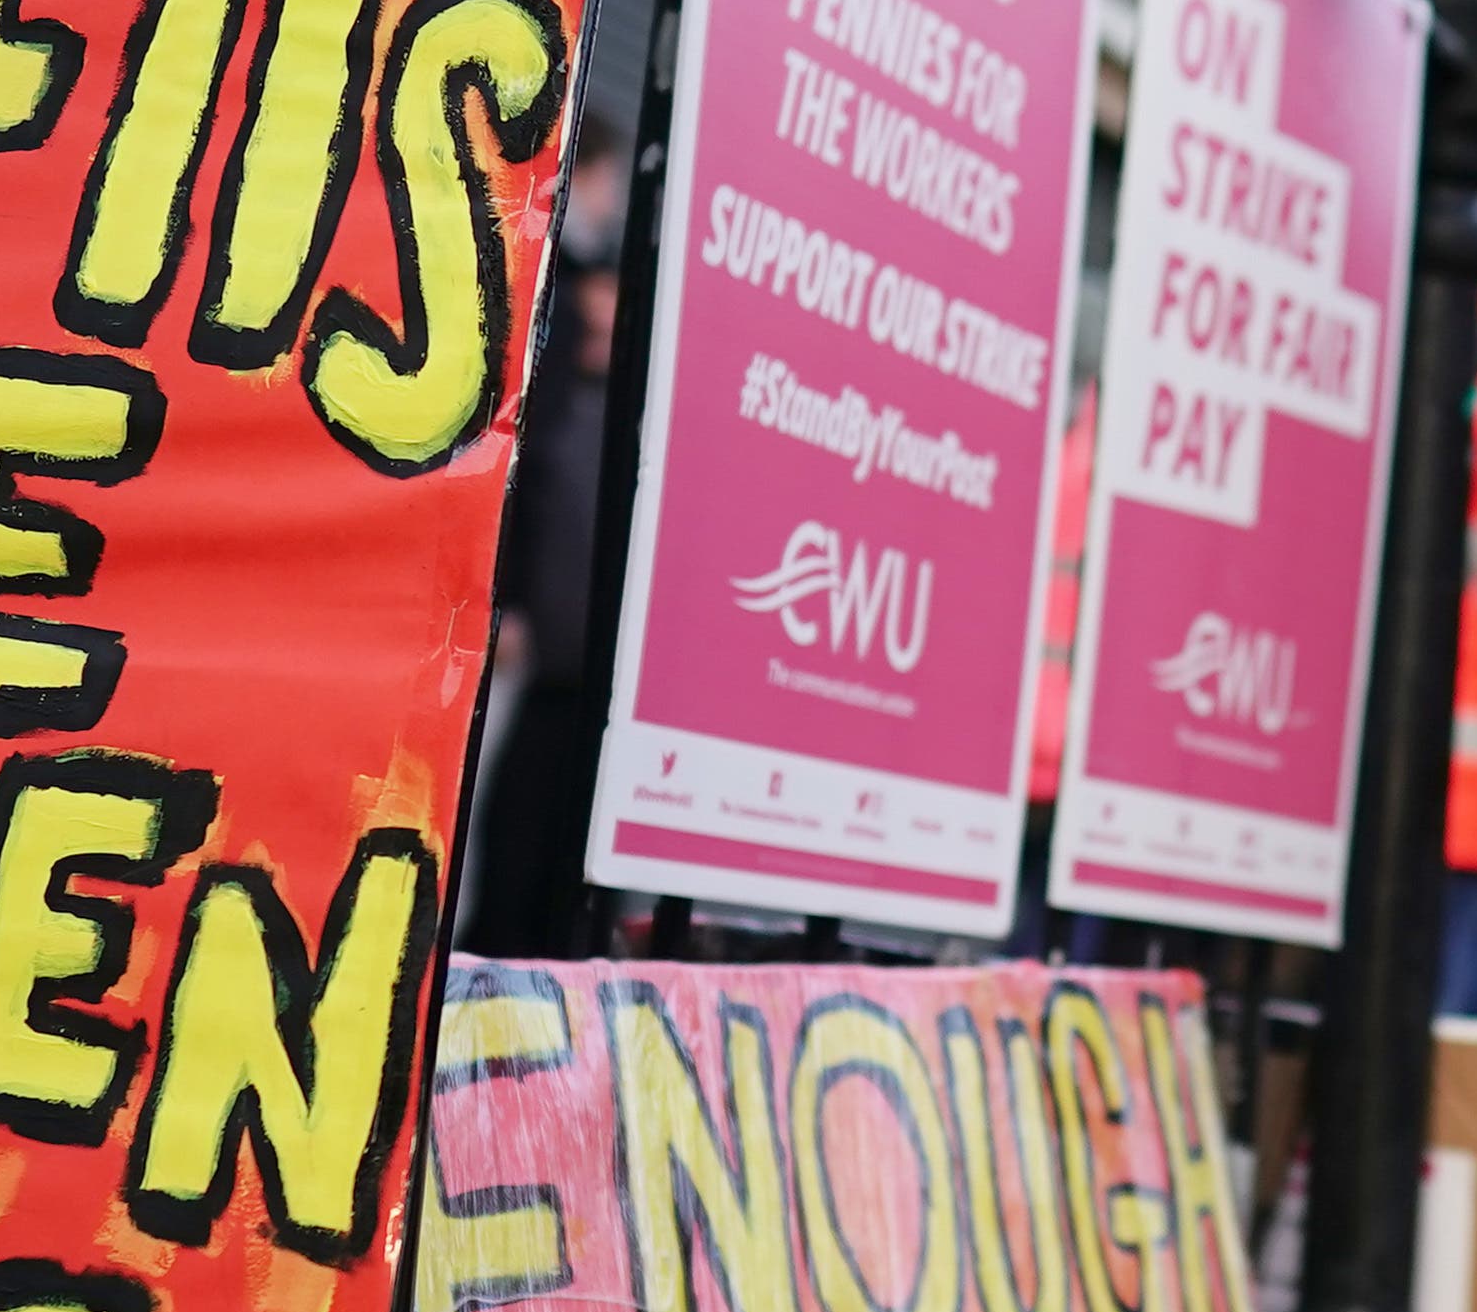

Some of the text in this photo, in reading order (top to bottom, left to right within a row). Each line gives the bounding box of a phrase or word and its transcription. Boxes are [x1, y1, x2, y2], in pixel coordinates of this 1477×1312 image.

[775, 48, 1019, 256] THE WORKERS
[952, 39, 1028, 151] FOR
[1163, 120, 1329, 267] STRIKE
[701, 183, 1048, 411] SUPPORT OUR STRIKE
[1151, 253, 1356, 403] FOR FAIR
[739, 350, 998, 512] #StandByYourPost
[1139, 384, 1245, 490] PAY
[728, 519, 934, 673] CWU
